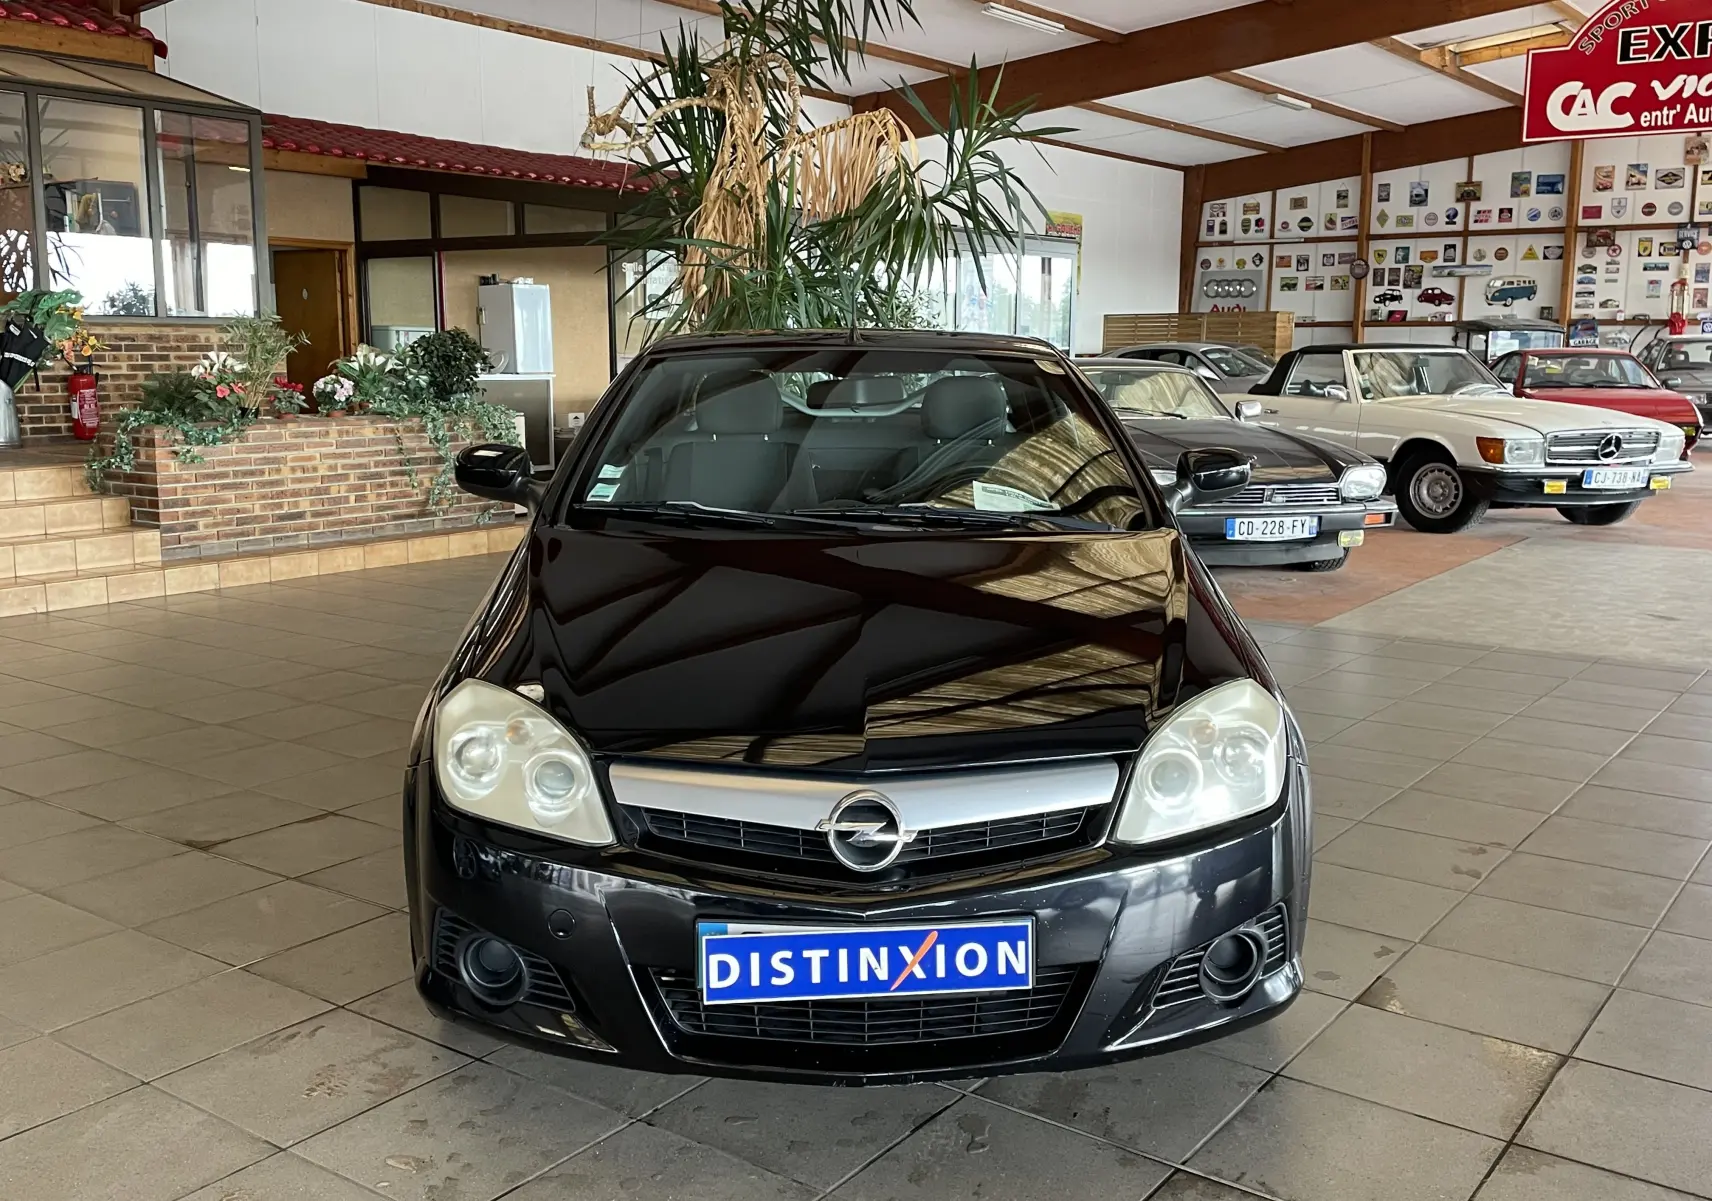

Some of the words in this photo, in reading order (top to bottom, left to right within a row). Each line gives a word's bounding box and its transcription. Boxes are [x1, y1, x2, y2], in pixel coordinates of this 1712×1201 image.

[1546, 81, 1637, 132] CAC
[1640, 103, 1681, 128] entr'
[1573, 338, 1597, 346] GARAGE
[1238, 519, 1307, 536] CD-228-FY
[708, 930, 1027, 991] DISTINXION
